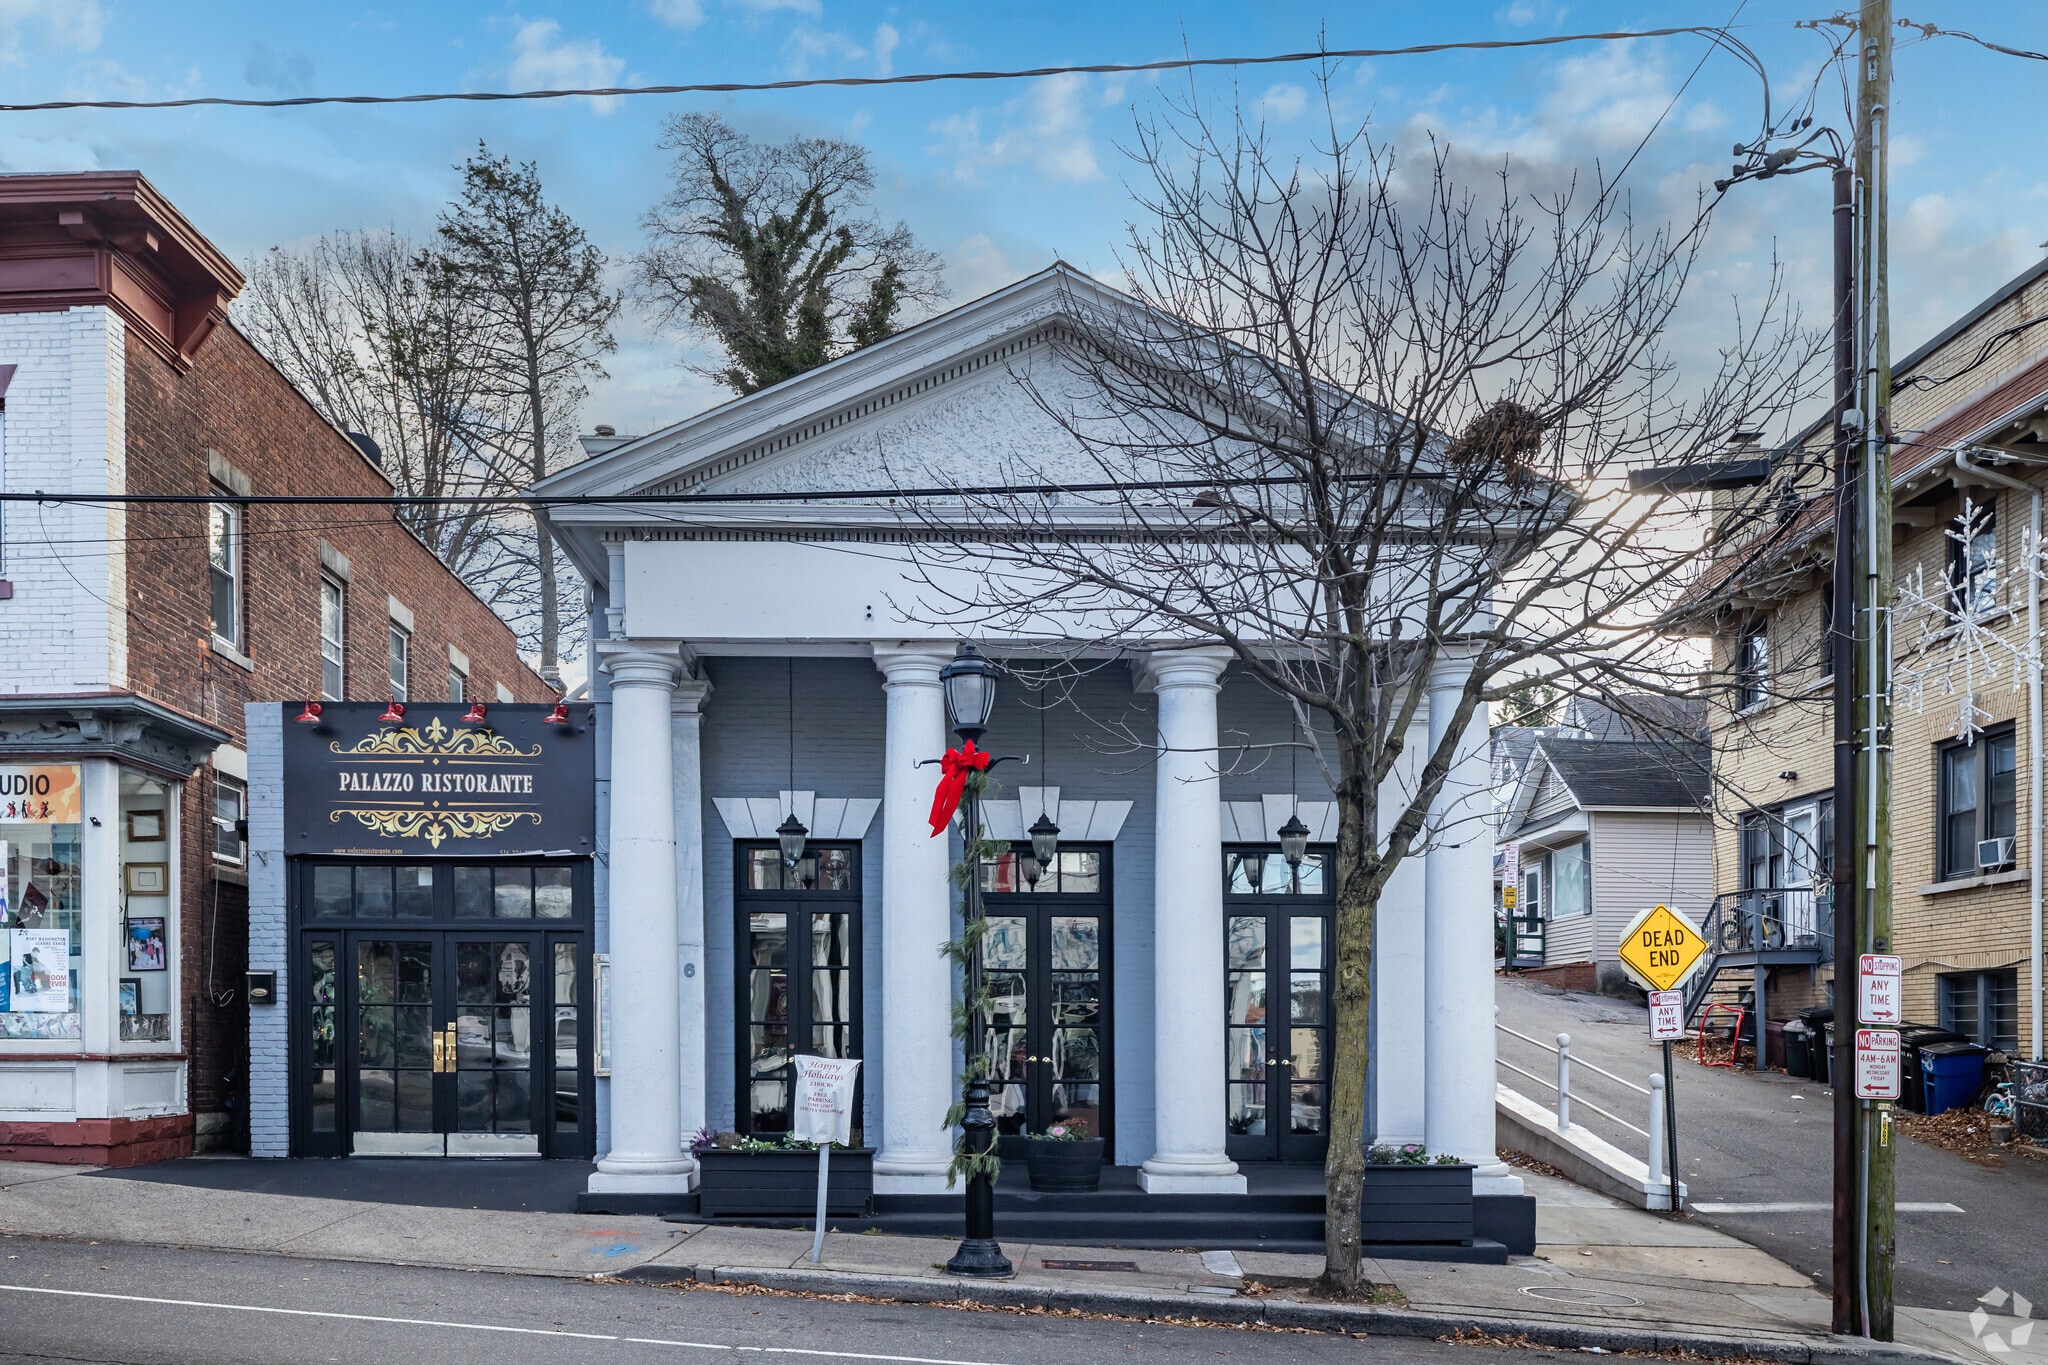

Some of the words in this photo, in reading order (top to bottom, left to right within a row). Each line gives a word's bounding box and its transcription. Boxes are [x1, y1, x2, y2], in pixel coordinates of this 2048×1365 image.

[339, 772, 414, 792] PALAZZO
[421, 773, 533, 794] RISTORANTE
[1643, 930, 1684, 947] DEAD
[1650, 950, 1680, 967] END
[683, 963, 696, 978] 6
[1862, 959, 1873, 972] NO
[1875, 961, 1898, 971] STOPPING
[1871, 980, 1889, 990] ANY
[1651, 994, 1659, 1005] NO
[1661, 993, 1680, 1003] STOPPING
[1870, 994, 1890, 1005] TIME
[1659, 1007, 1674, 1016] ANY
[1658, 1017, 1677, 1026] TIME
[1859, 1034, 1870, 1047] NO
[1872, 1036, 1897, 1047] PARKING
[808, 1061, 841, 1071] Happy
[802, 1070, 844, 1082] Holidays
